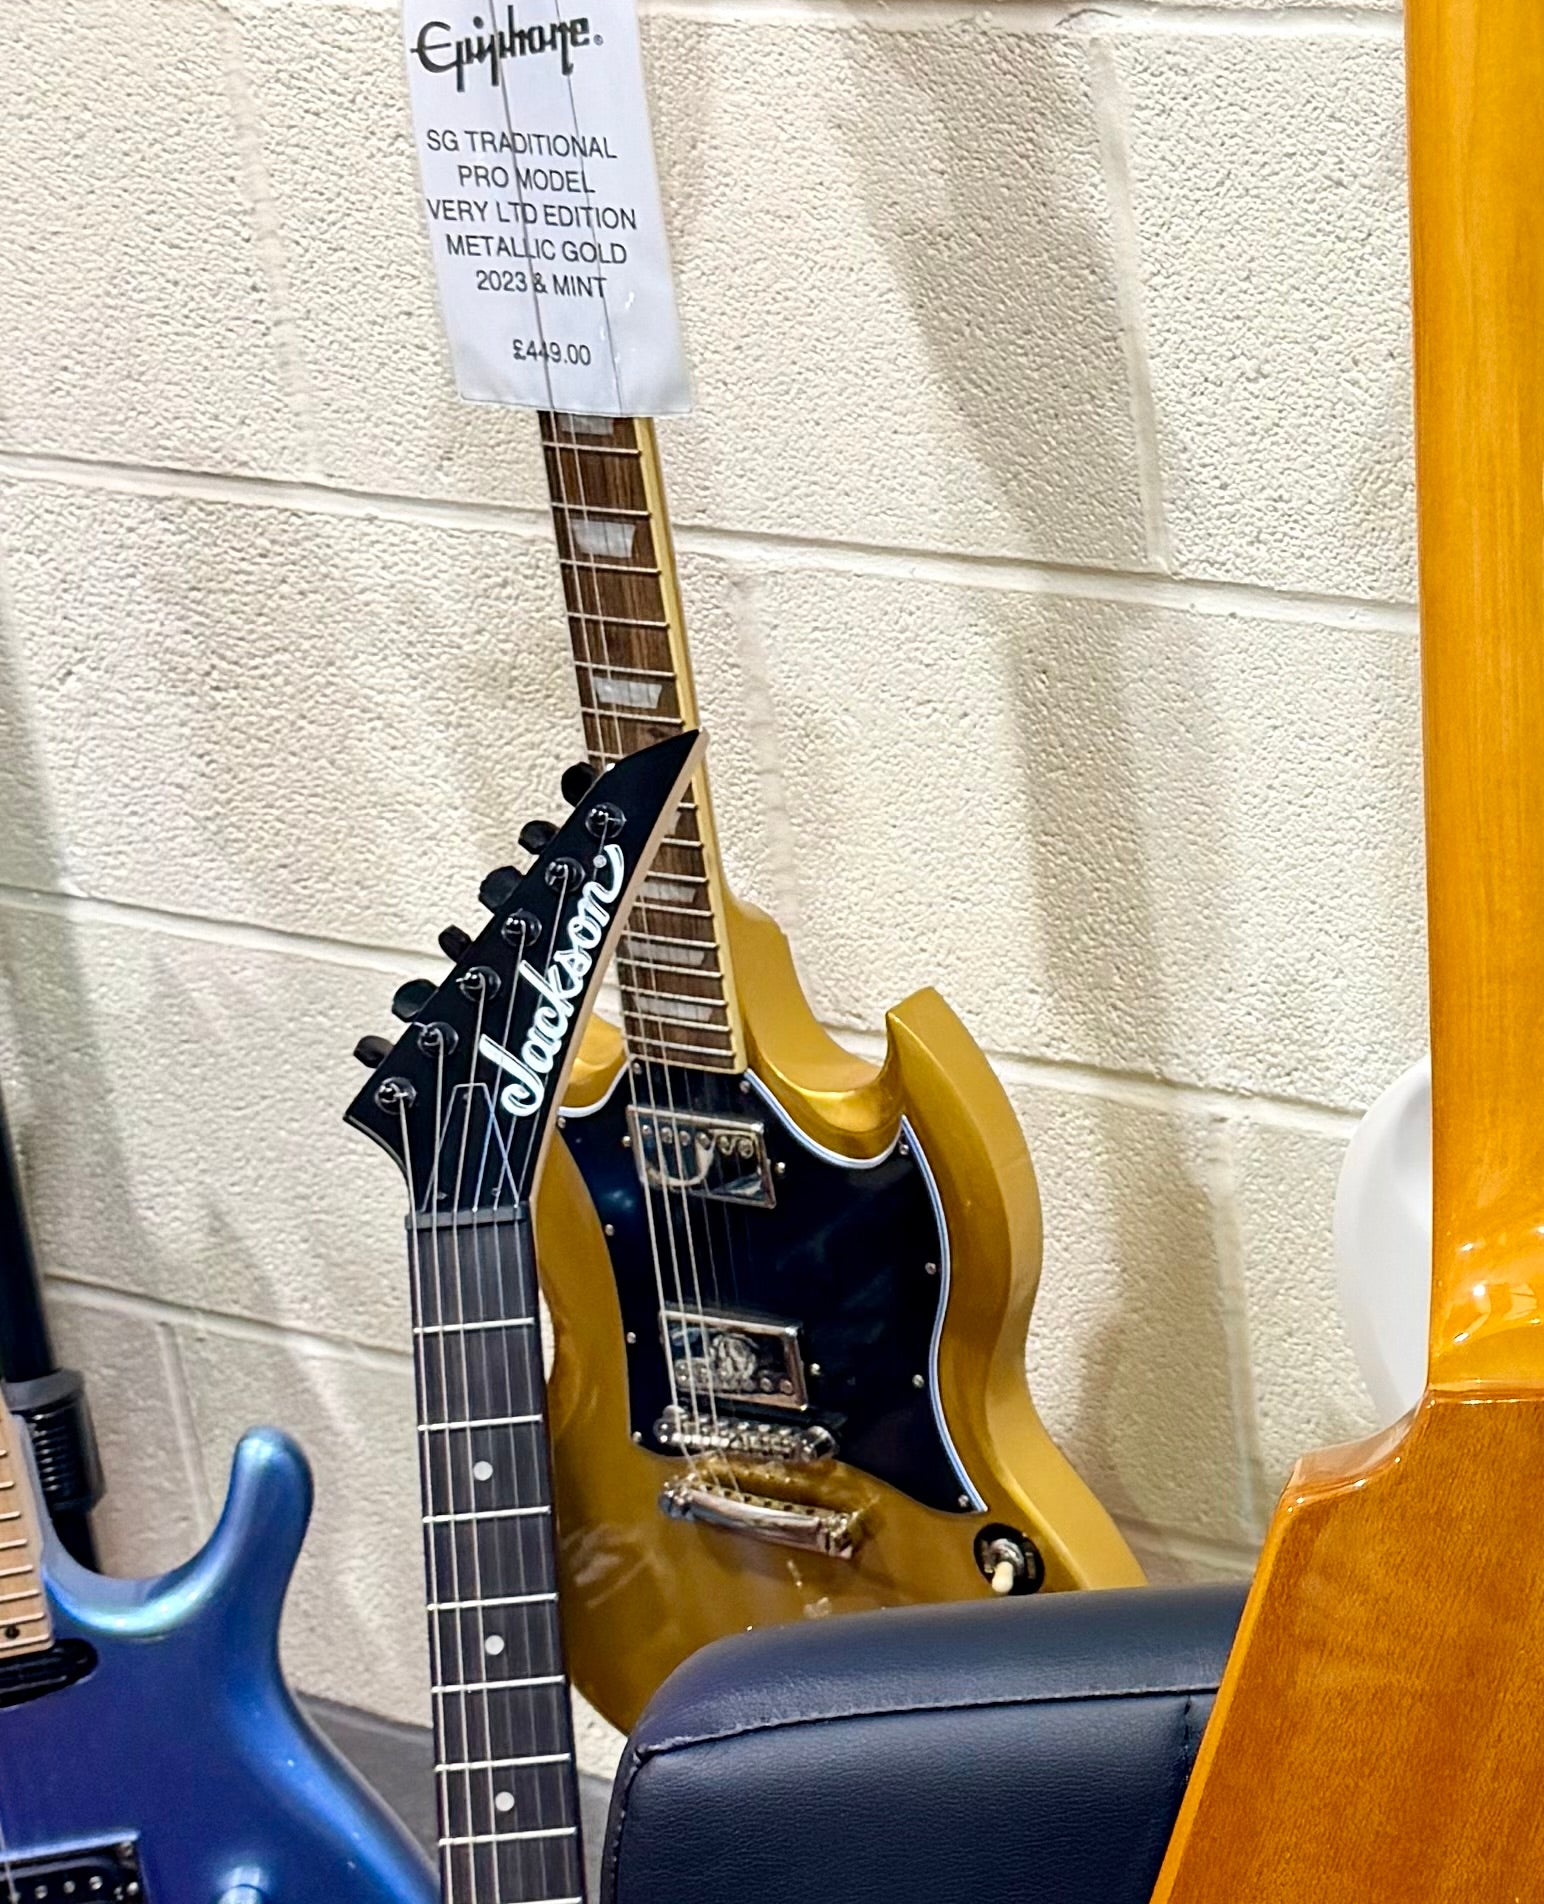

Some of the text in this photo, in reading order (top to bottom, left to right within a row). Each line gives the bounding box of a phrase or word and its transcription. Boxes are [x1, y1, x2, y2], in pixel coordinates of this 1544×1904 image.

[410, 4, 591, 92] Epiphone
[426, 129, 618, 160] SG TRADITIONAL
[457, 165, 596, 194] PRO MODEL
[427, 198, 637, 230] VERY LTD EDITION
[446, 234, 628, 265] METALLIC GOLD
[476, 270, 607, 298] 2023 & MINT
[512, 338, 592, 366] £449.00
[478, 844, 626, 1118] Jackson
